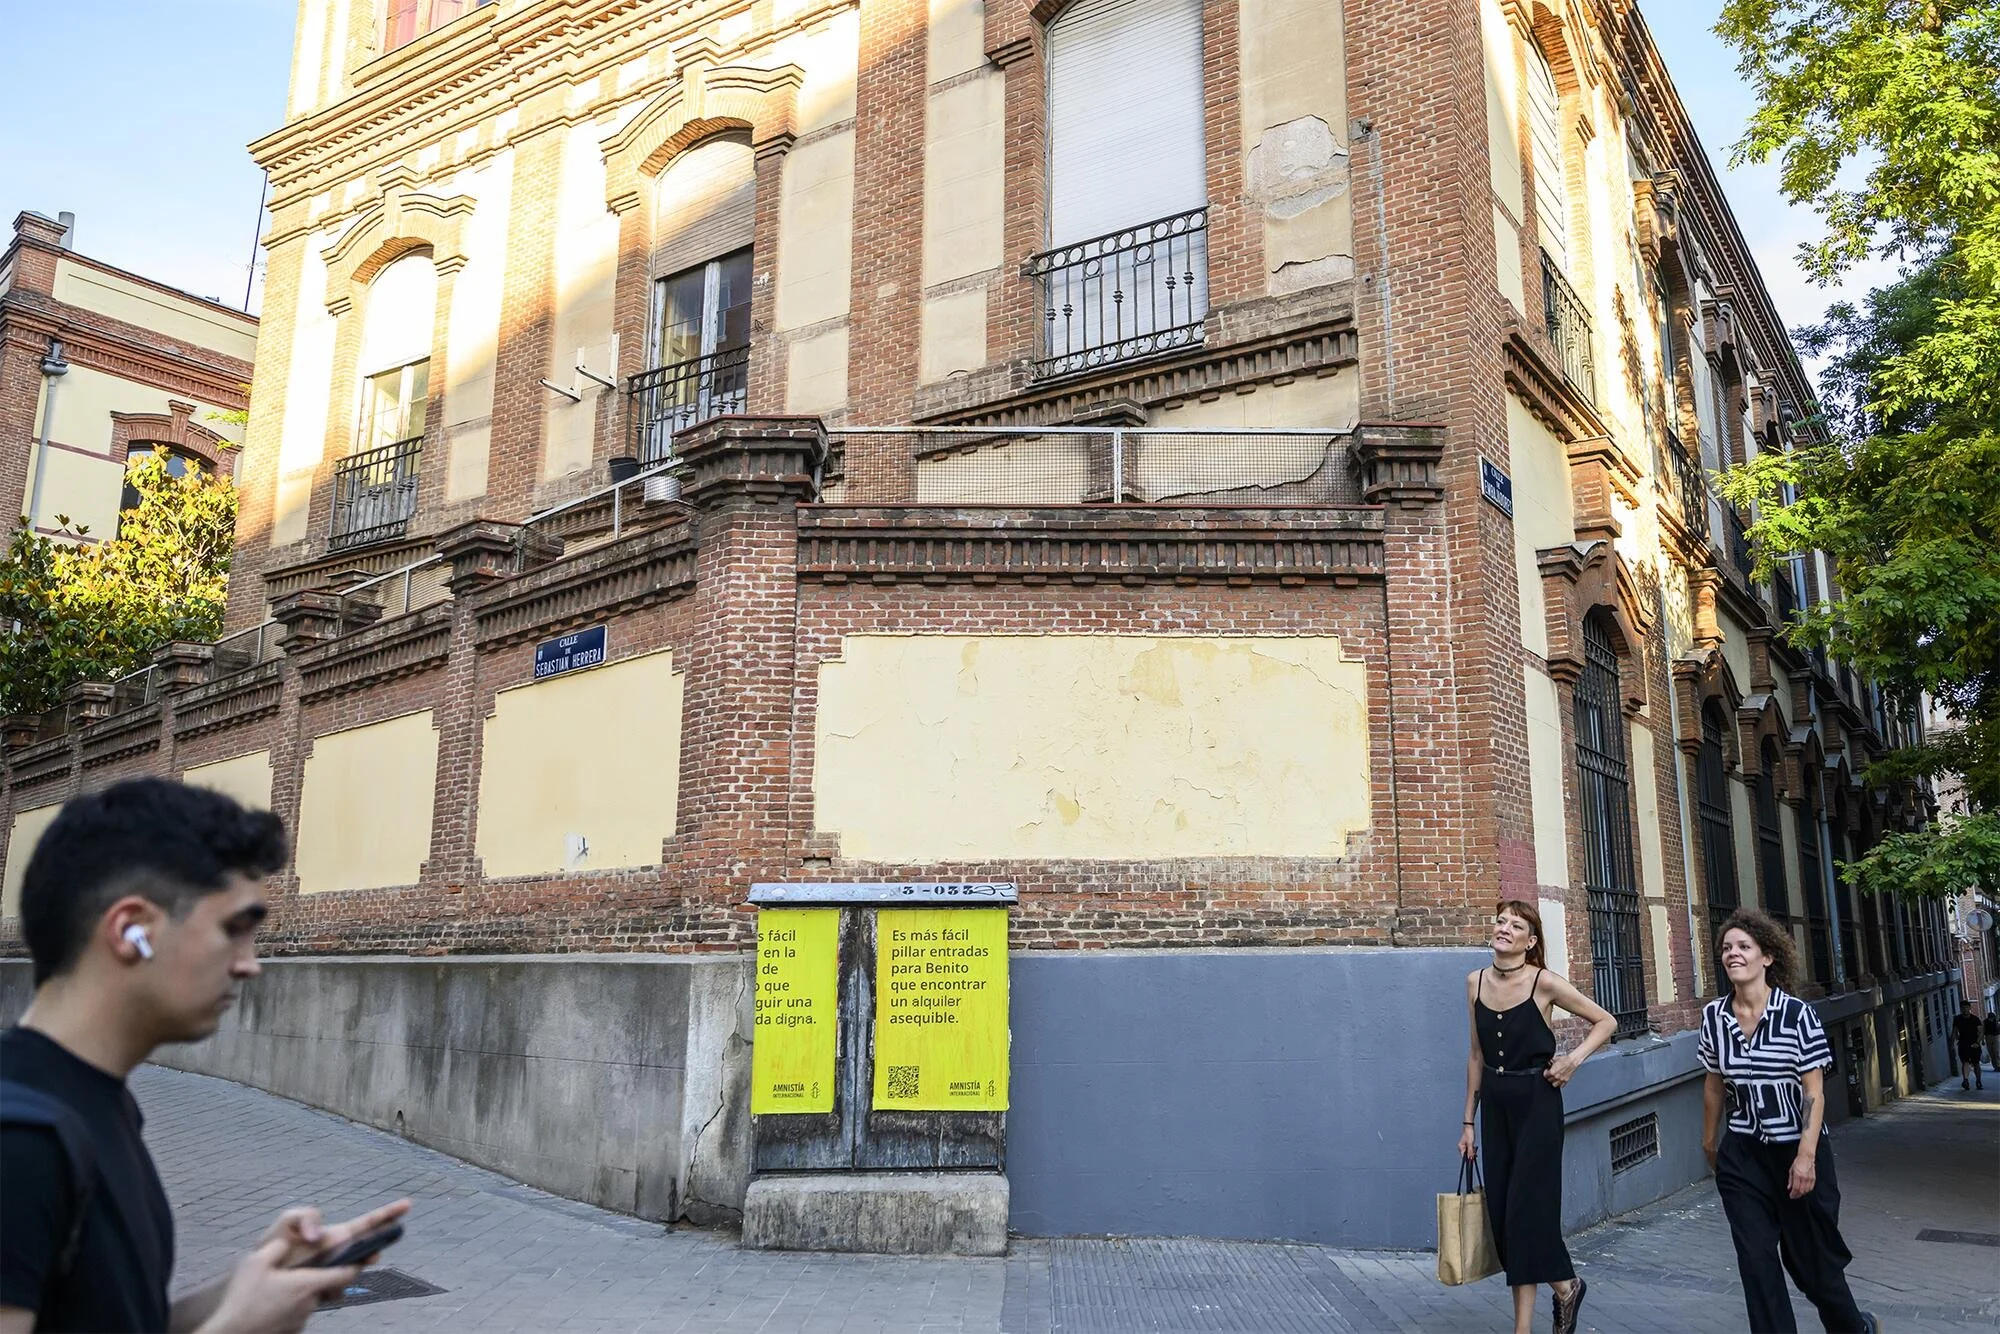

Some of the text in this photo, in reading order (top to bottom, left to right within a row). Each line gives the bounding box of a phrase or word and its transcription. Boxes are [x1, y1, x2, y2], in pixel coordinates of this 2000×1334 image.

[559, 635, 578, 647] CALLE
[565, 647, 571, 655] DE
[536, 648, 601, 676] SEBASTIAN HERRERA
[768, 929, 796, 941] fácil
[892, 929, 969, 941] Es más fácil
[763, 949, 780, 958] en
[784, 946, 796, 958] la
[892, 945, 989, 960] pillar entradas
[762, 963, 779, 975] de
[892, 962, 969, 977] para Benito
[764, 982, 790, 995] que
[891, 980, 987, 993] que encontrar
[787, 998, 812, 1008] una
[890, 995, 962, 1009] un alquiler
[775, 1013, 817, 1027] digna.
[889, 1012, 959, 1027] asequible.
[773, 1082, 804, 1092] AMNISTÍA
[949, 1080, 981, 1090] AMNISTÍA
